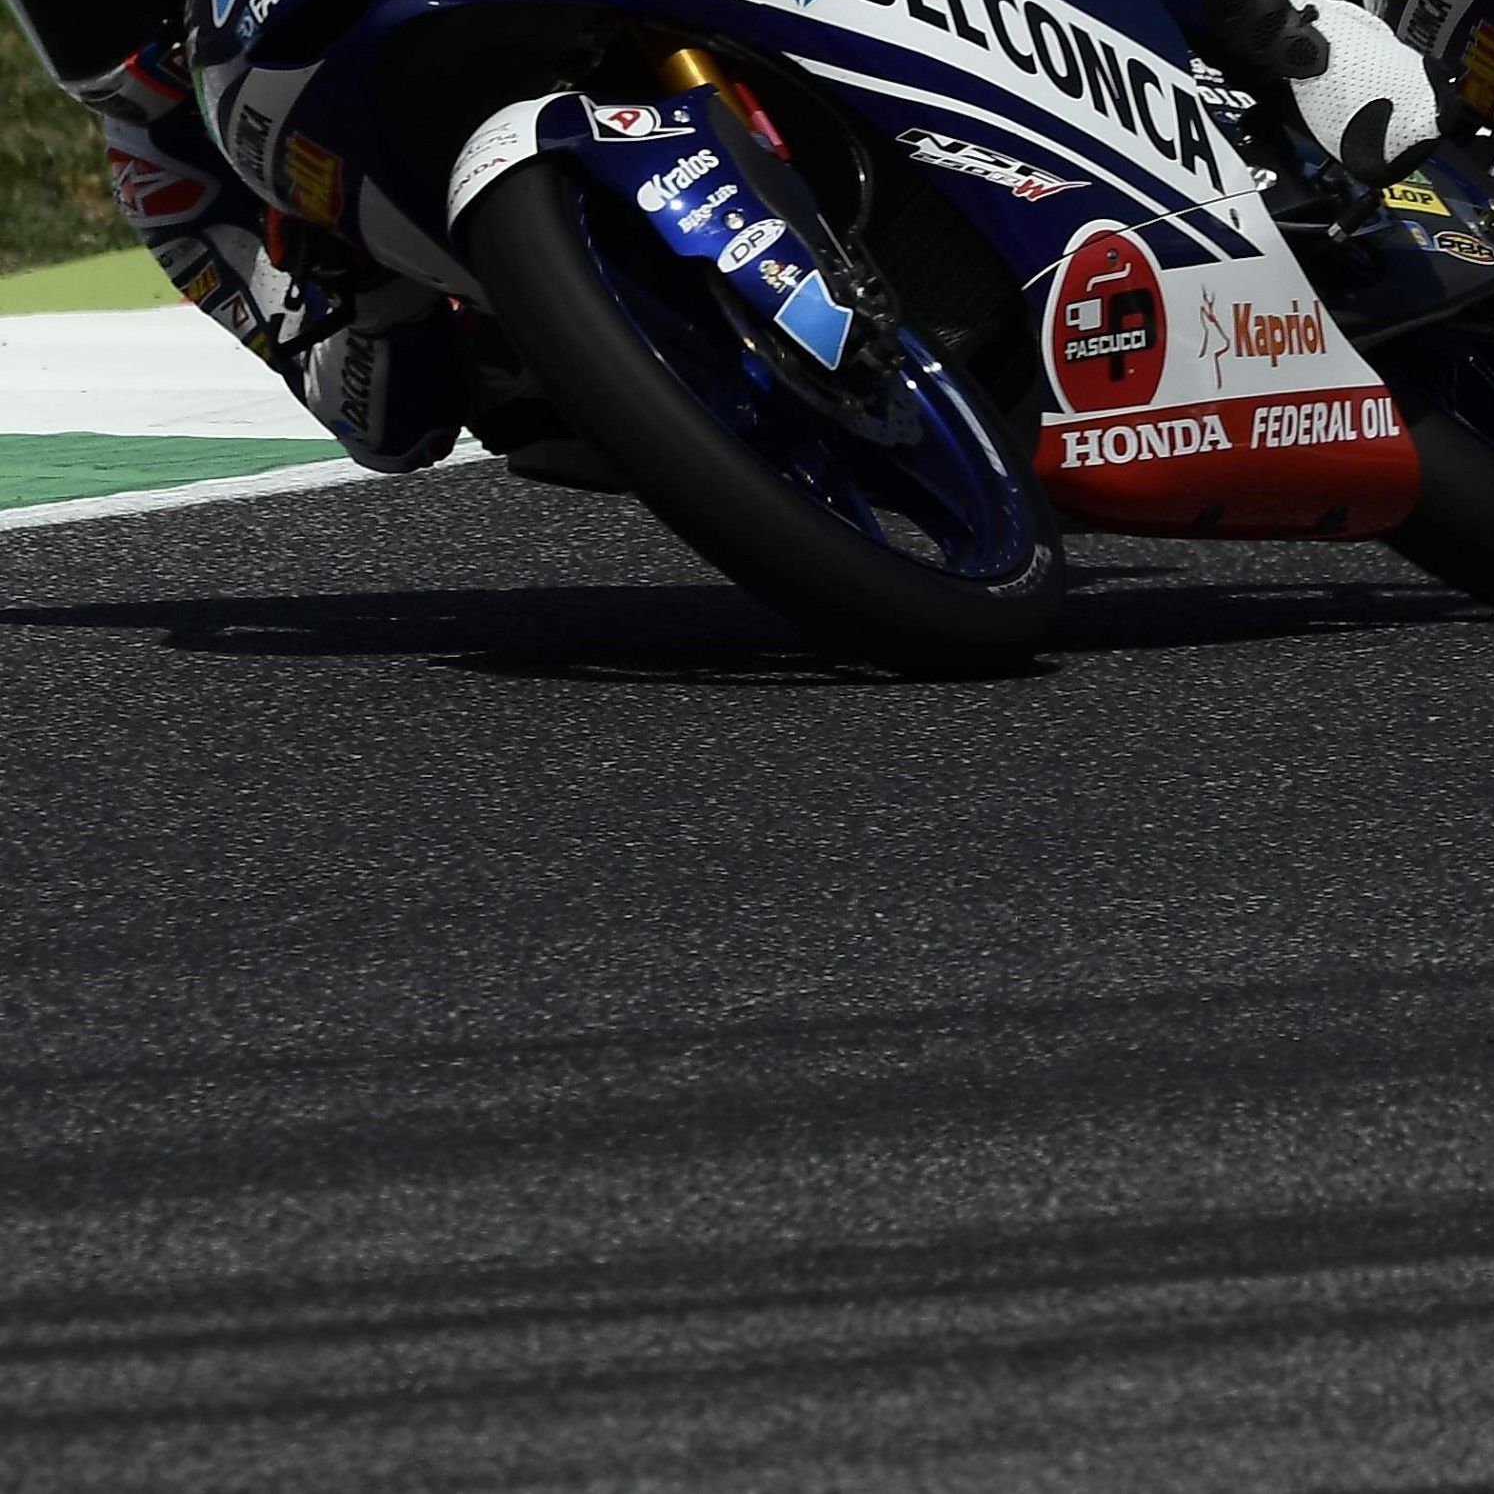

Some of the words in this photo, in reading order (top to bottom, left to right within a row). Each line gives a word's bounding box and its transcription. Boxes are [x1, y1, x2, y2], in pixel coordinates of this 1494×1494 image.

[1063, 327, 1147, 363] PASCUCCI
[1231, 298, 1327, 368] Kapriol
[1060, 413, 1233, 470] HONDA
[1250, 401, 1358, 450] FEDERAL
[1361, 396, 1401, 440] OIL
